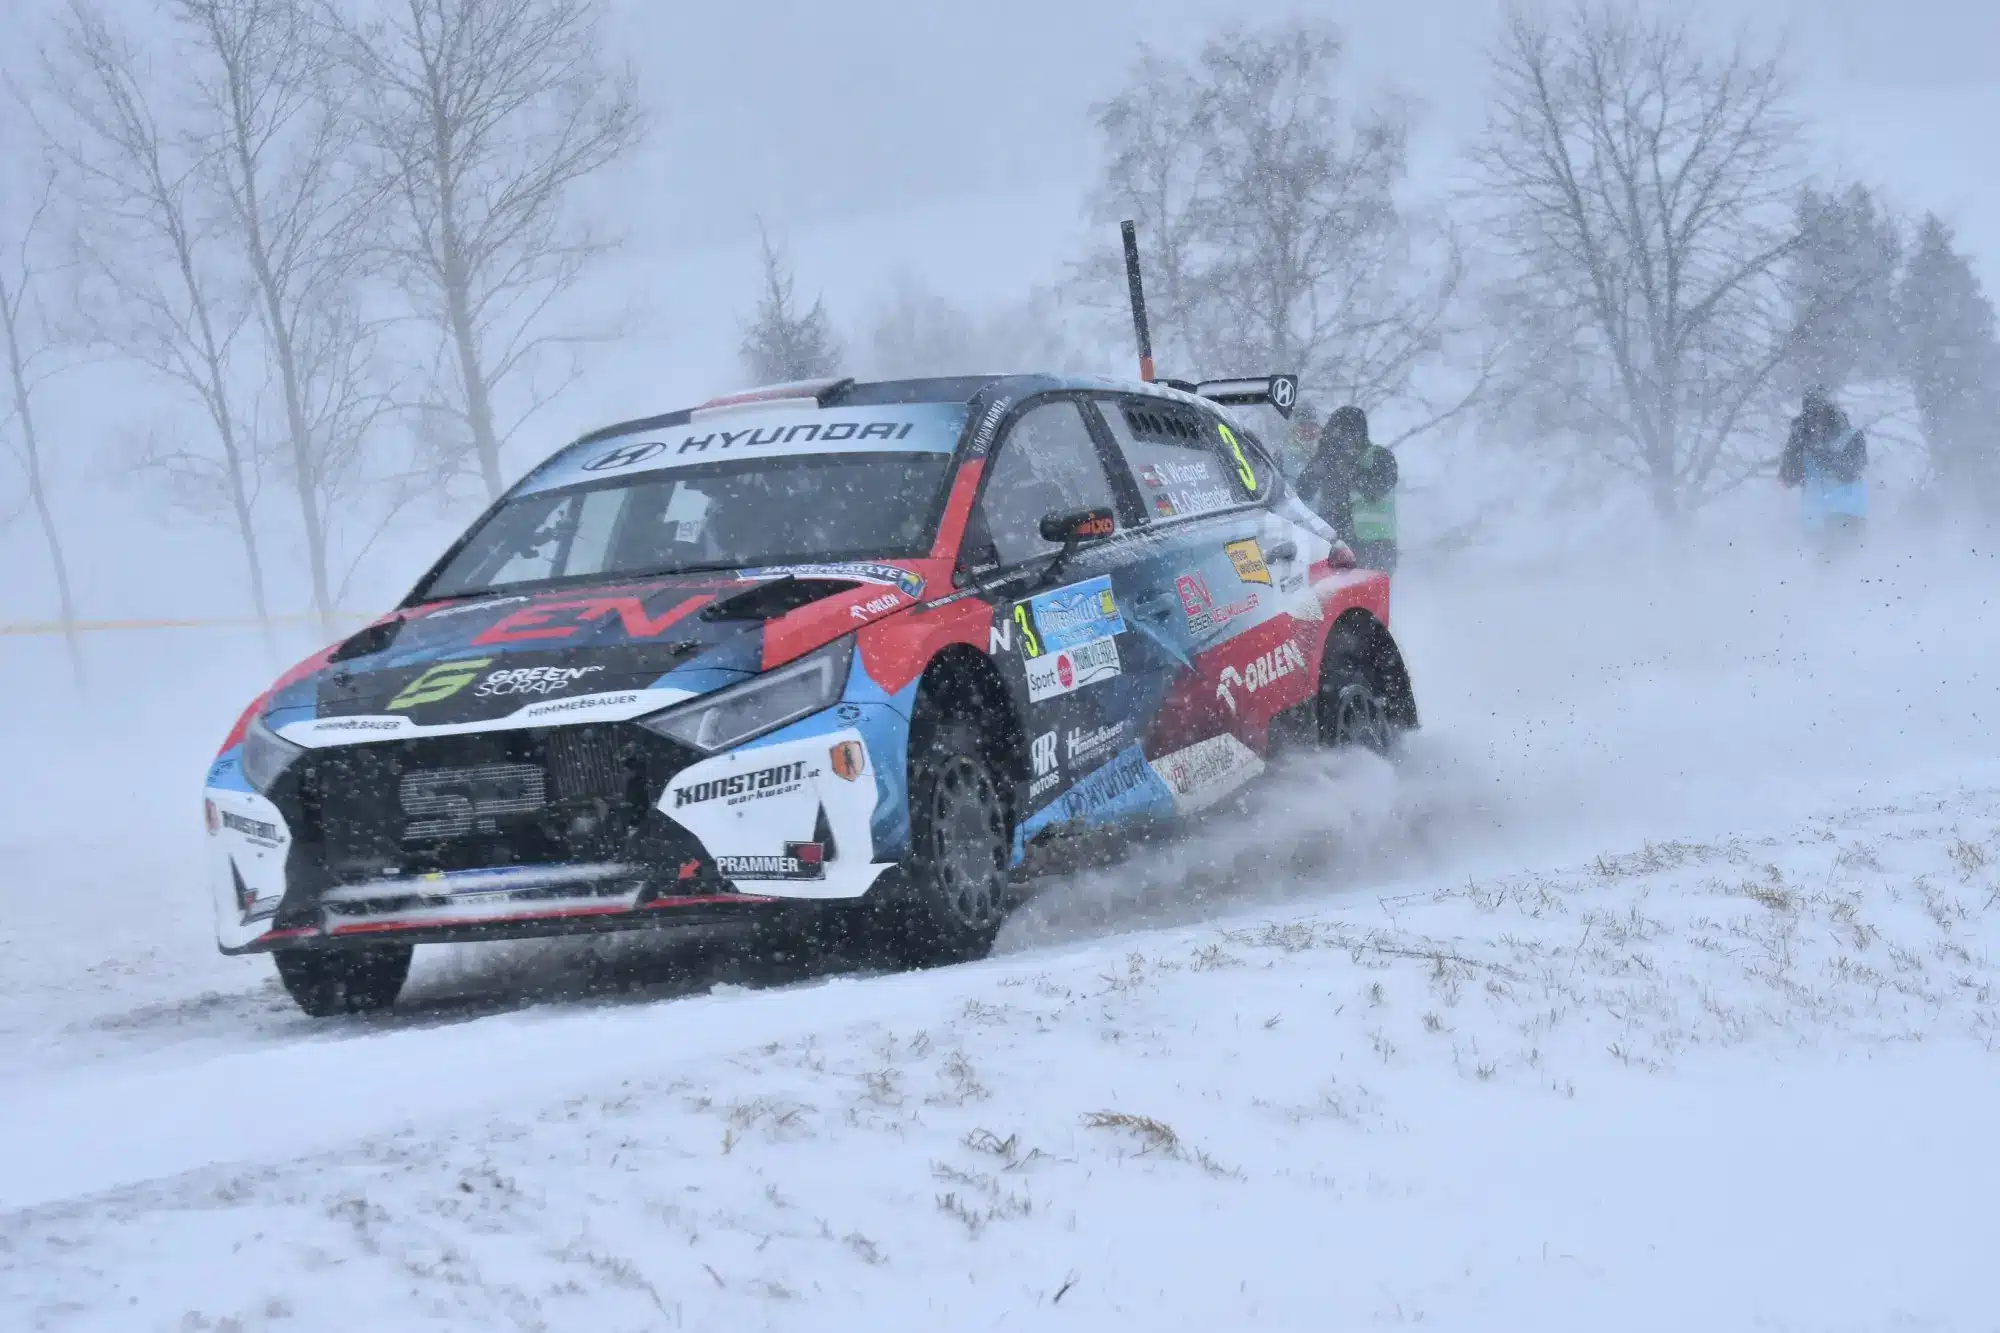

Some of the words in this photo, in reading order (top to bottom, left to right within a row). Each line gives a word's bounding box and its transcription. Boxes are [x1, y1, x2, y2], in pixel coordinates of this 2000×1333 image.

[677, 422, 914, 454] HYUNDAI
[1218, 424, 1256, 490] 3
[867, 593, 900, 614] ORLEN
[1014, 604, 1038, 658] 3
[1244, 638, 1306, 693] ORLEN
[473, 680, 569, 698] SCRAP
[1029, 667, 1057, 696] Sport
[727, 783, 802, 806] workwear
[1029, 770, 1060, 799] MOTORS
[716, 857, 799, 873] PRAMMER
